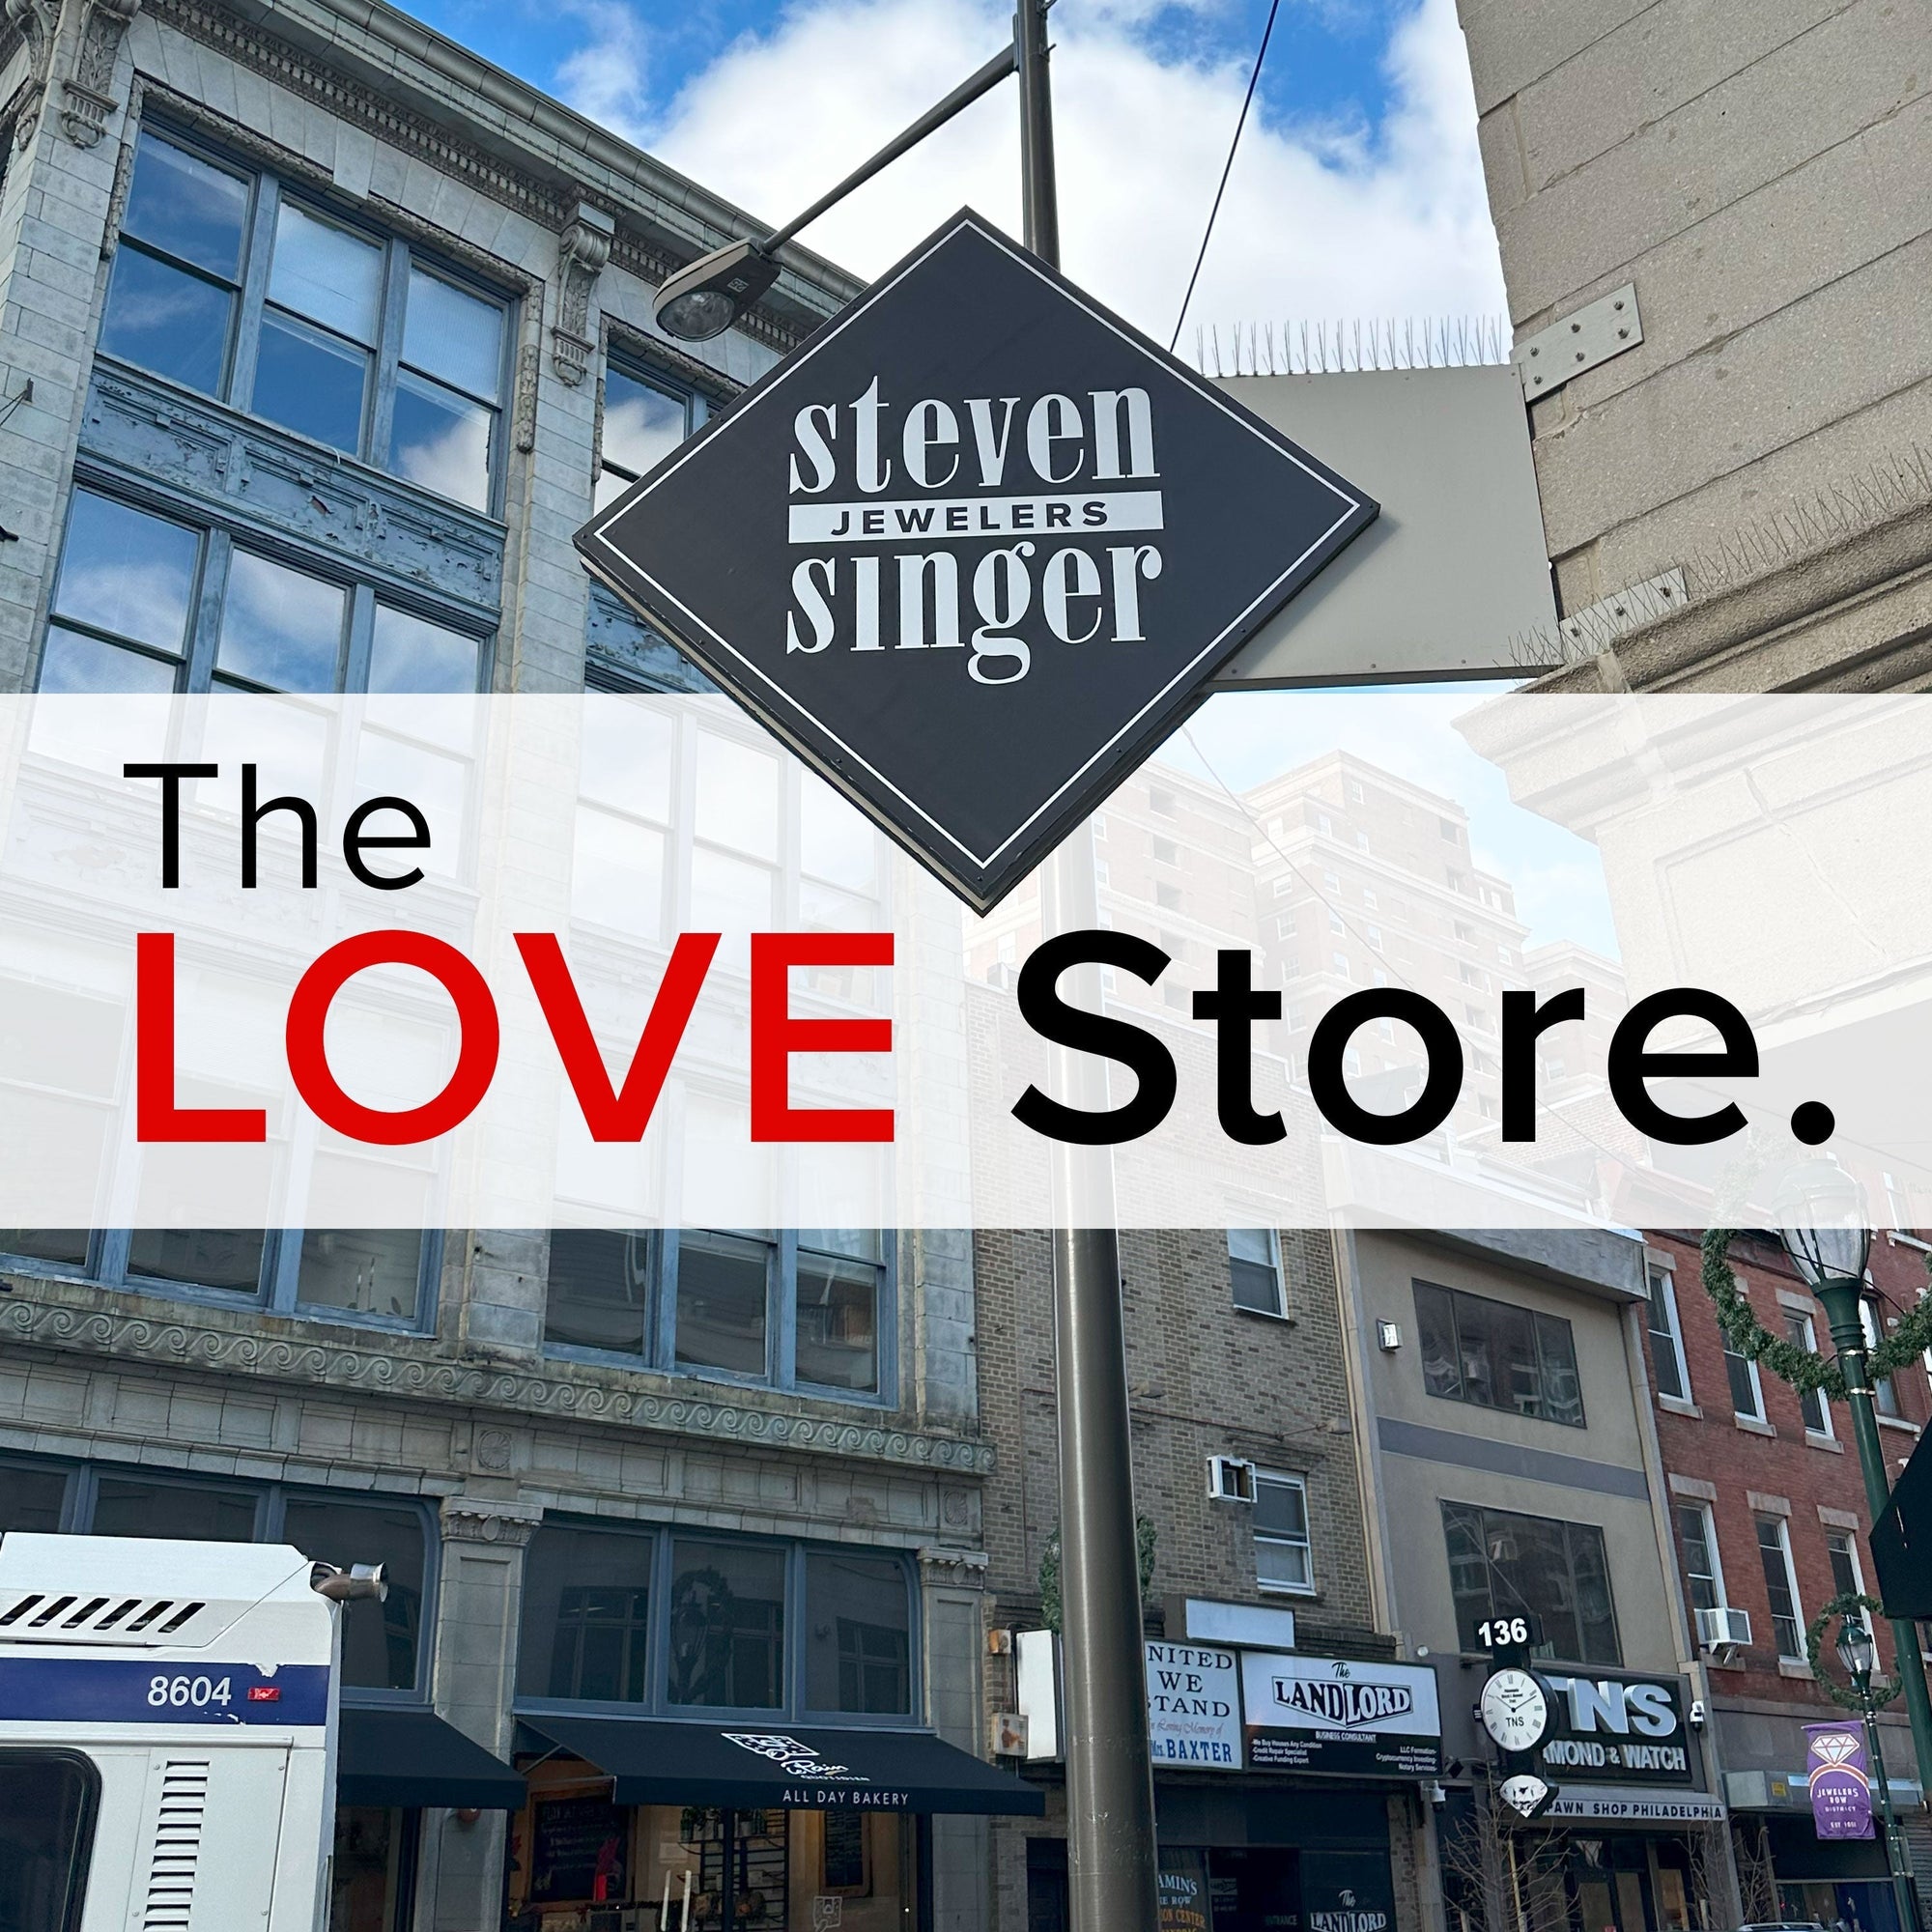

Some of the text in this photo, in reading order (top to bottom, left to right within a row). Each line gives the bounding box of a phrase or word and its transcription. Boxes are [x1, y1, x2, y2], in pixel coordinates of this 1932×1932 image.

[789, 375, 1160, 495] steven
[831, 500, 1108, 536] JEWELERS
[786, 541, 1163, 685] singer
[1478, 1617, 1528, 1646] 136
[1149, 1645, 1233, 1669] NITED
[1157, 1670, 1203, 1692] WE
[1332, 1662, 1350, 1679] The
[148, 1675, 232, 1706] 8604
[1275, 1681, 1410, 1722] LANDLORD
[1148, 1695, 1231, 1718] TAND
[1506, 1717, 1524, 1727] TNS
[1166, 1739, 1232, 1762] BAXTER
[1543, 1740, 1687, 1771] MOND & WATCH
[782, 1789, 908, 1805] ALL DAY BAKERY
[1817, 1787, 1859, 1798] JEWELERS
[1594, 1803, 1628, 1815] SHOP
[1634, 1804, 1721, 1818] PHILADELPHIA
[1158, 1874, 1198, 1896] AMIN'S
